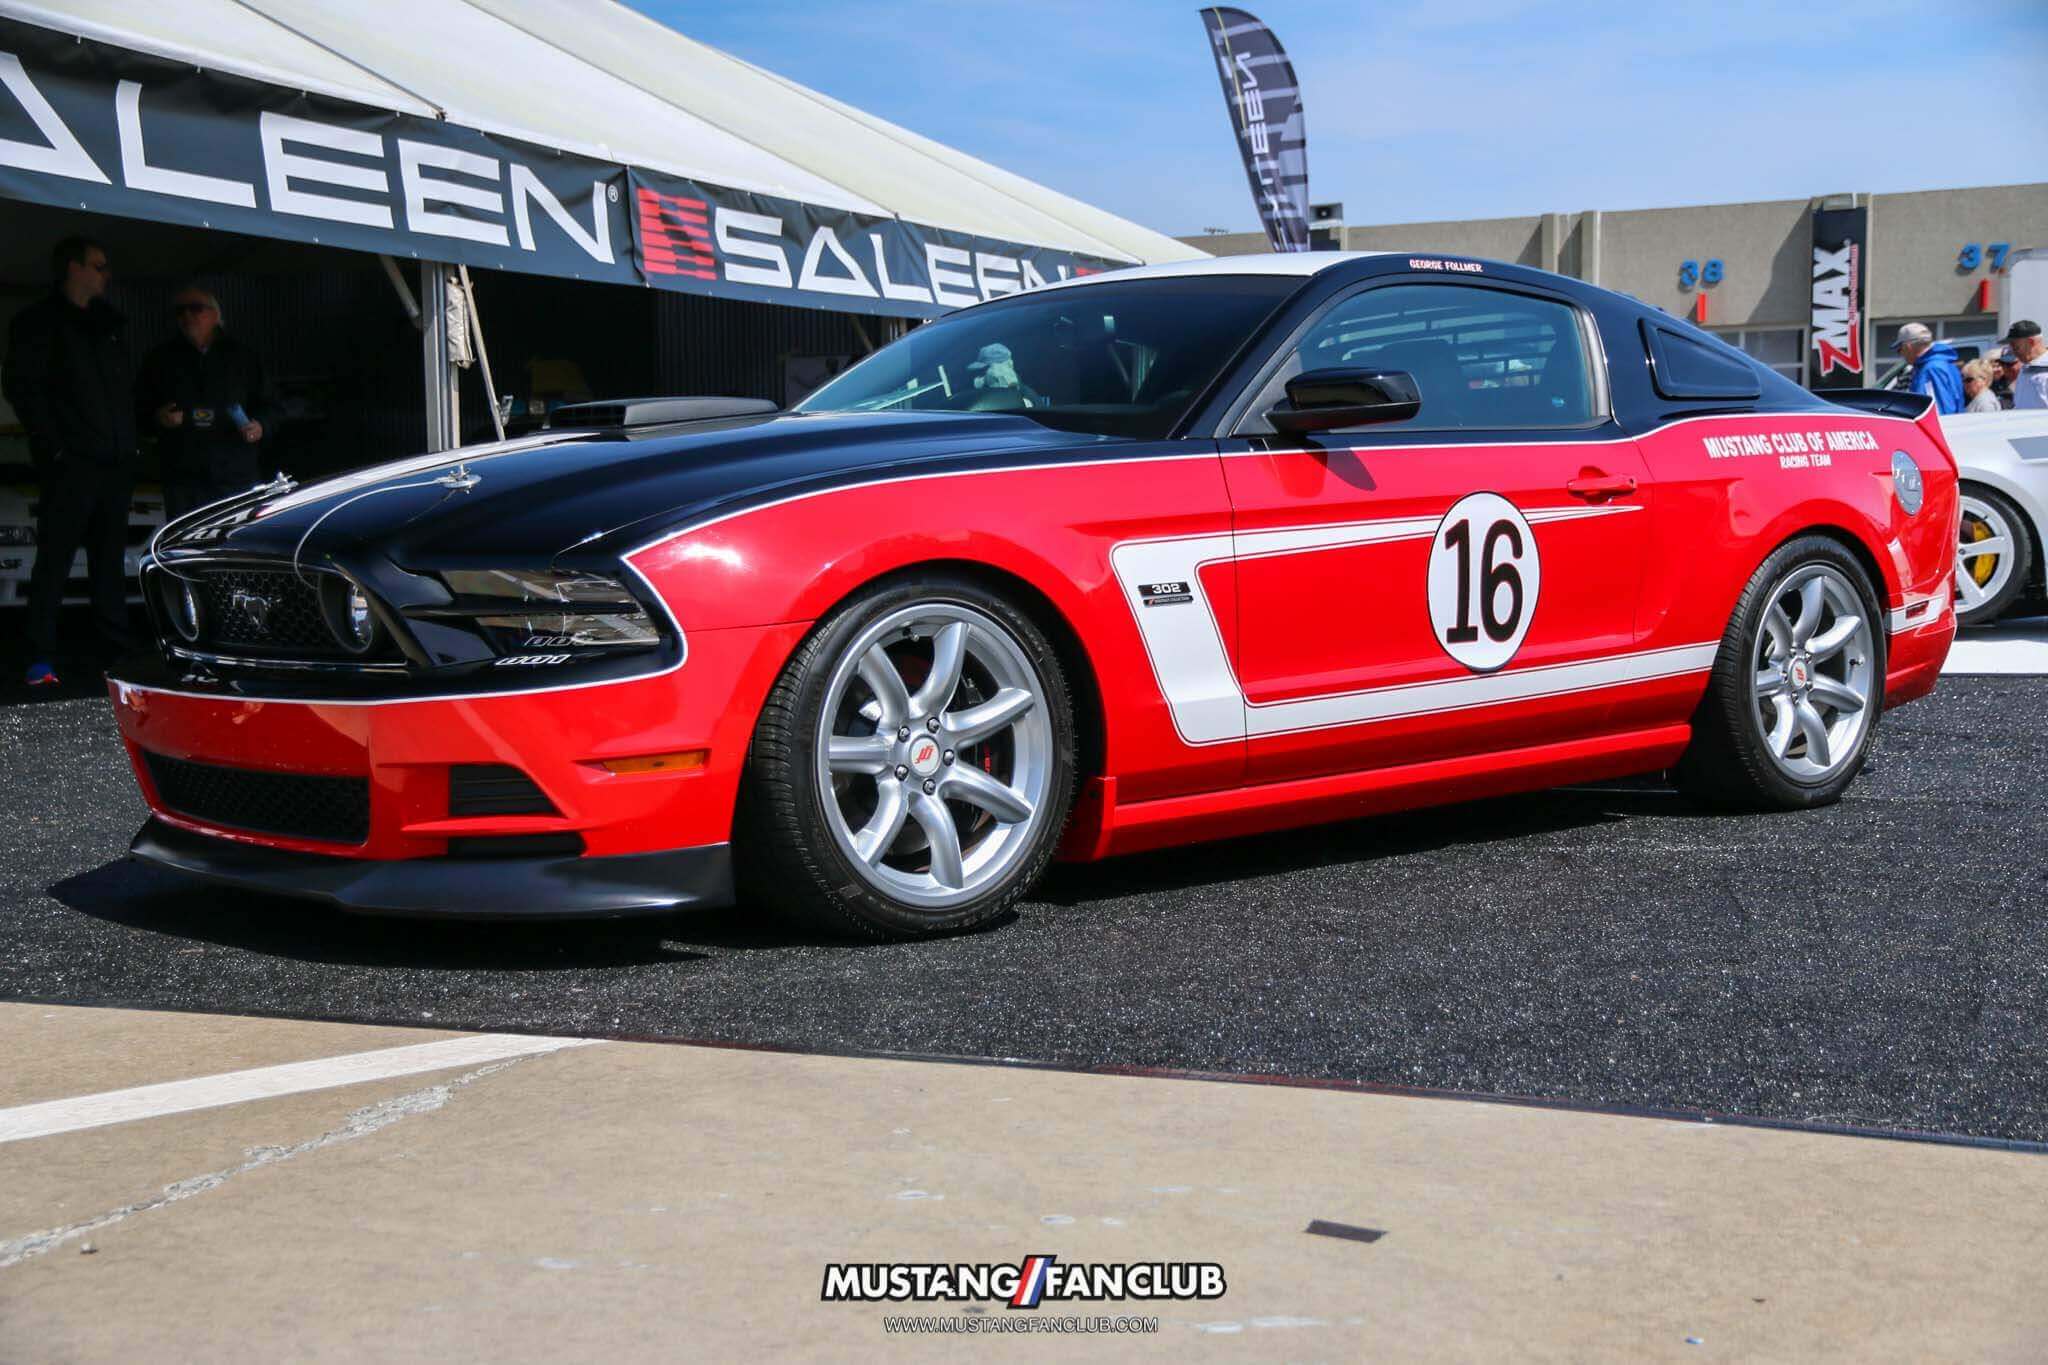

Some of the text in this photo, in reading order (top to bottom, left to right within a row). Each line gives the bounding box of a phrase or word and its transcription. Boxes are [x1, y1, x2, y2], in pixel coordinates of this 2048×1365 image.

[1959, 242, 2010, 271] 37
[1679, 259, 1725, 287] 38
[1702, 431, 1880, 458] MUSTANG CLUB OF AMERICA
[1779, 454, 1832, 469] RACING TEAM
[1152, 583, 1181, 594] 302
[1445, 519, 1523, 643] 16
